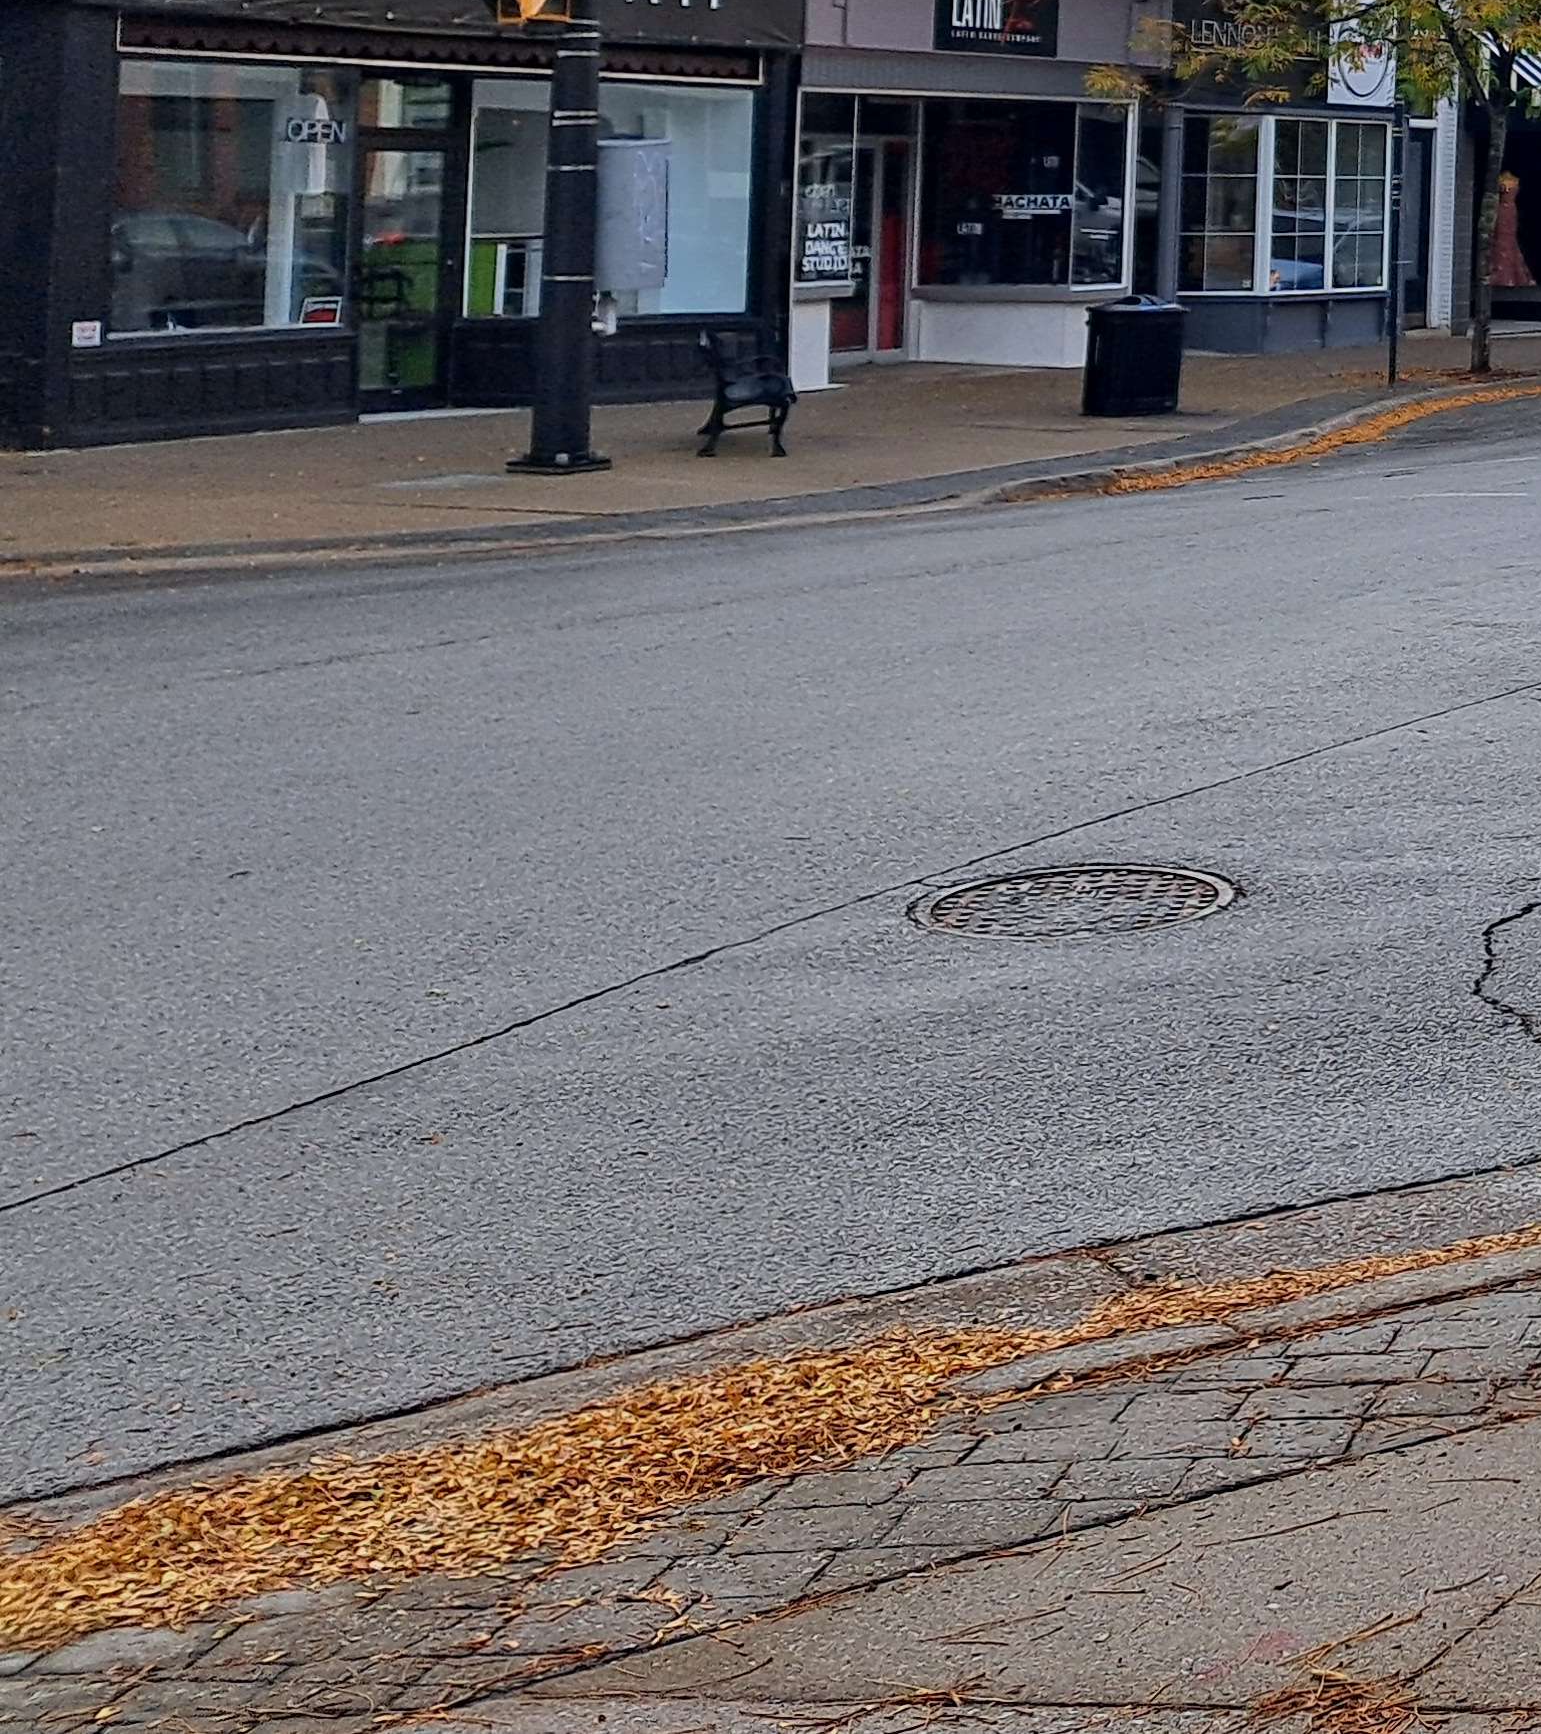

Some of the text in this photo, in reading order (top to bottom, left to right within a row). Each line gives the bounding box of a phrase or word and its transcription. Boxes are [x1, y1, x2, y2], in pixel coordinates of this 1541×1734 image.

[287, 119, 346, 143] OPEN
[807, 223, 846, 239] LATIN
[805, 239, 848, 256] DANCE
[802, 255, 848, 272] STUDIO
